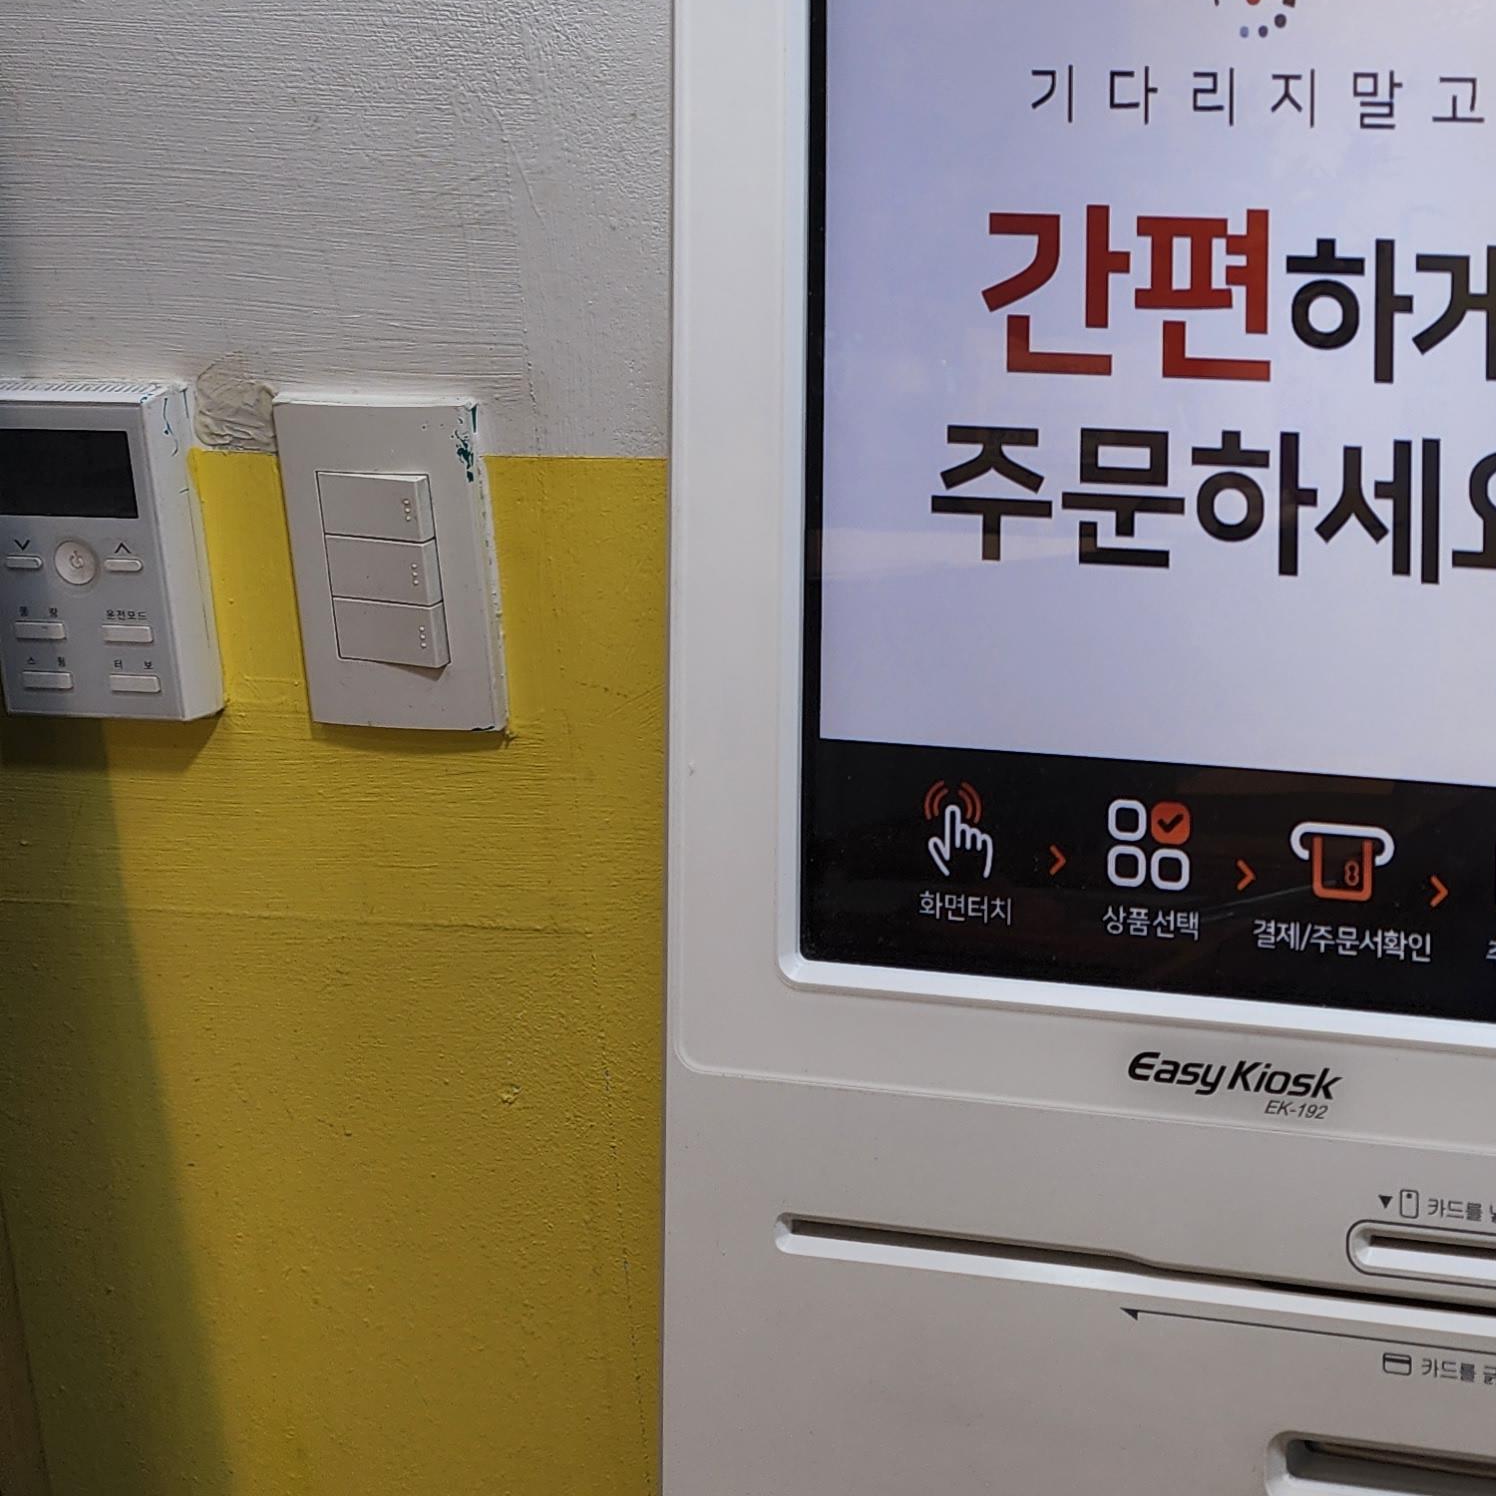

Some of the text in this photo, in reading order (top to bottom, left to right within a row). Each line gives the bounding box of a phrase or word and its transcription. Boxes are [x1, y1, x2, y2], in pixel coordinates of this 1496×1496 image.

[917, 889, 1013, 927] 화면터치
[1101, 904, 1202, 942] 상품선택
[1251, 917, 1433, 964] 결제/주문서확인
[1128, 1051, 1343, 1100] Easy Kiosk
[1264, 1099, 1328, 1120] EK-192
[1427, 1198, 1483, 1222] 카드를
[1421, 1357, 1475, 1383] 카드를
